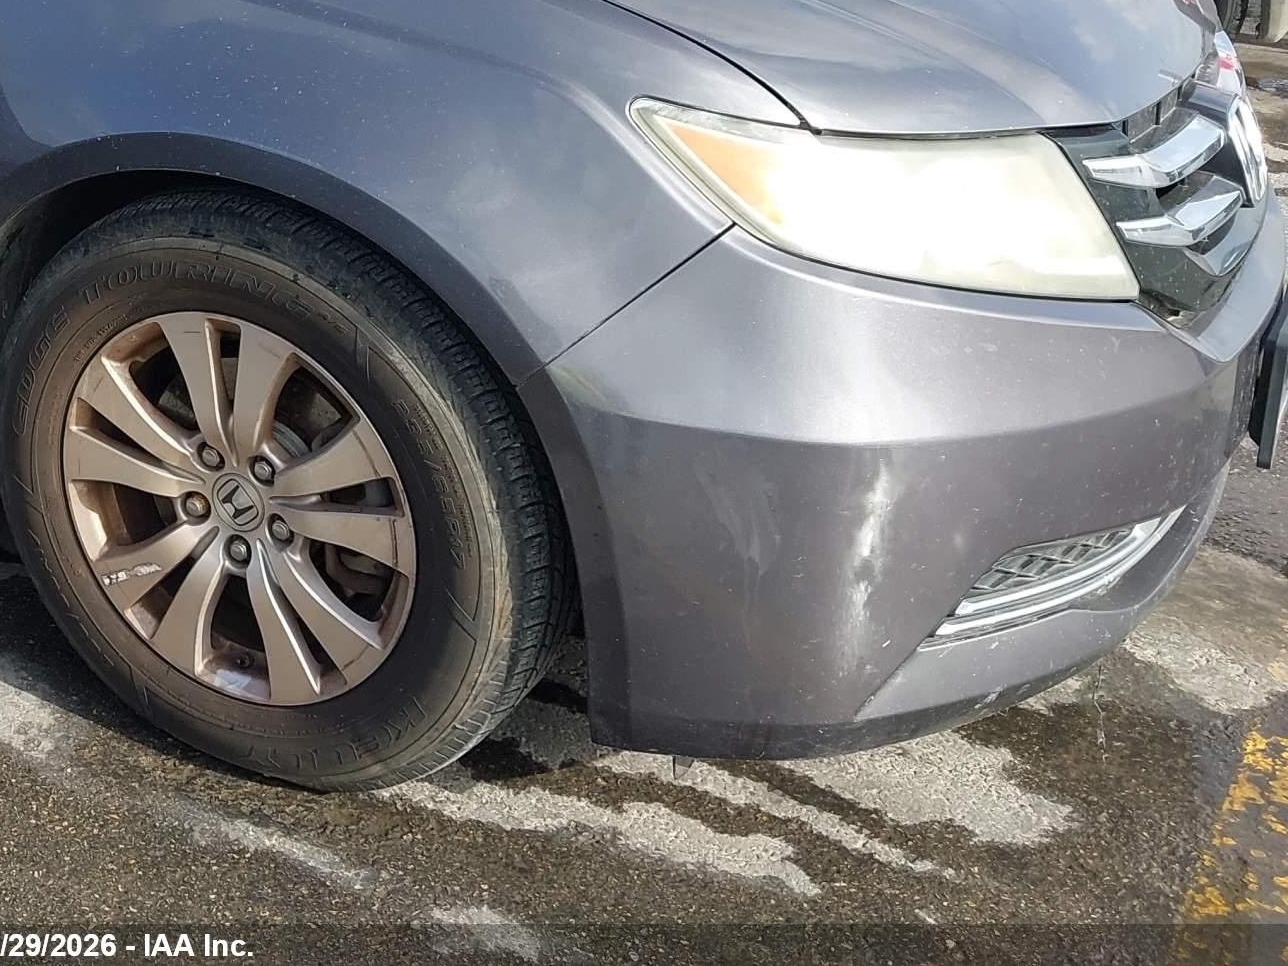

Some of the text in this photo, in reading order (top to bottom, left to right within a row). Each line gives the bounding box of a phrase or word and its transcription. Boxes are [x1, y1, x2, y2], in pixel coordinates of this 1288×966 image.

[13, 305, 72, 436] EDGE
[79, 260, 314, 321] TOURING
[240, 696, 427, 770] KELLY
